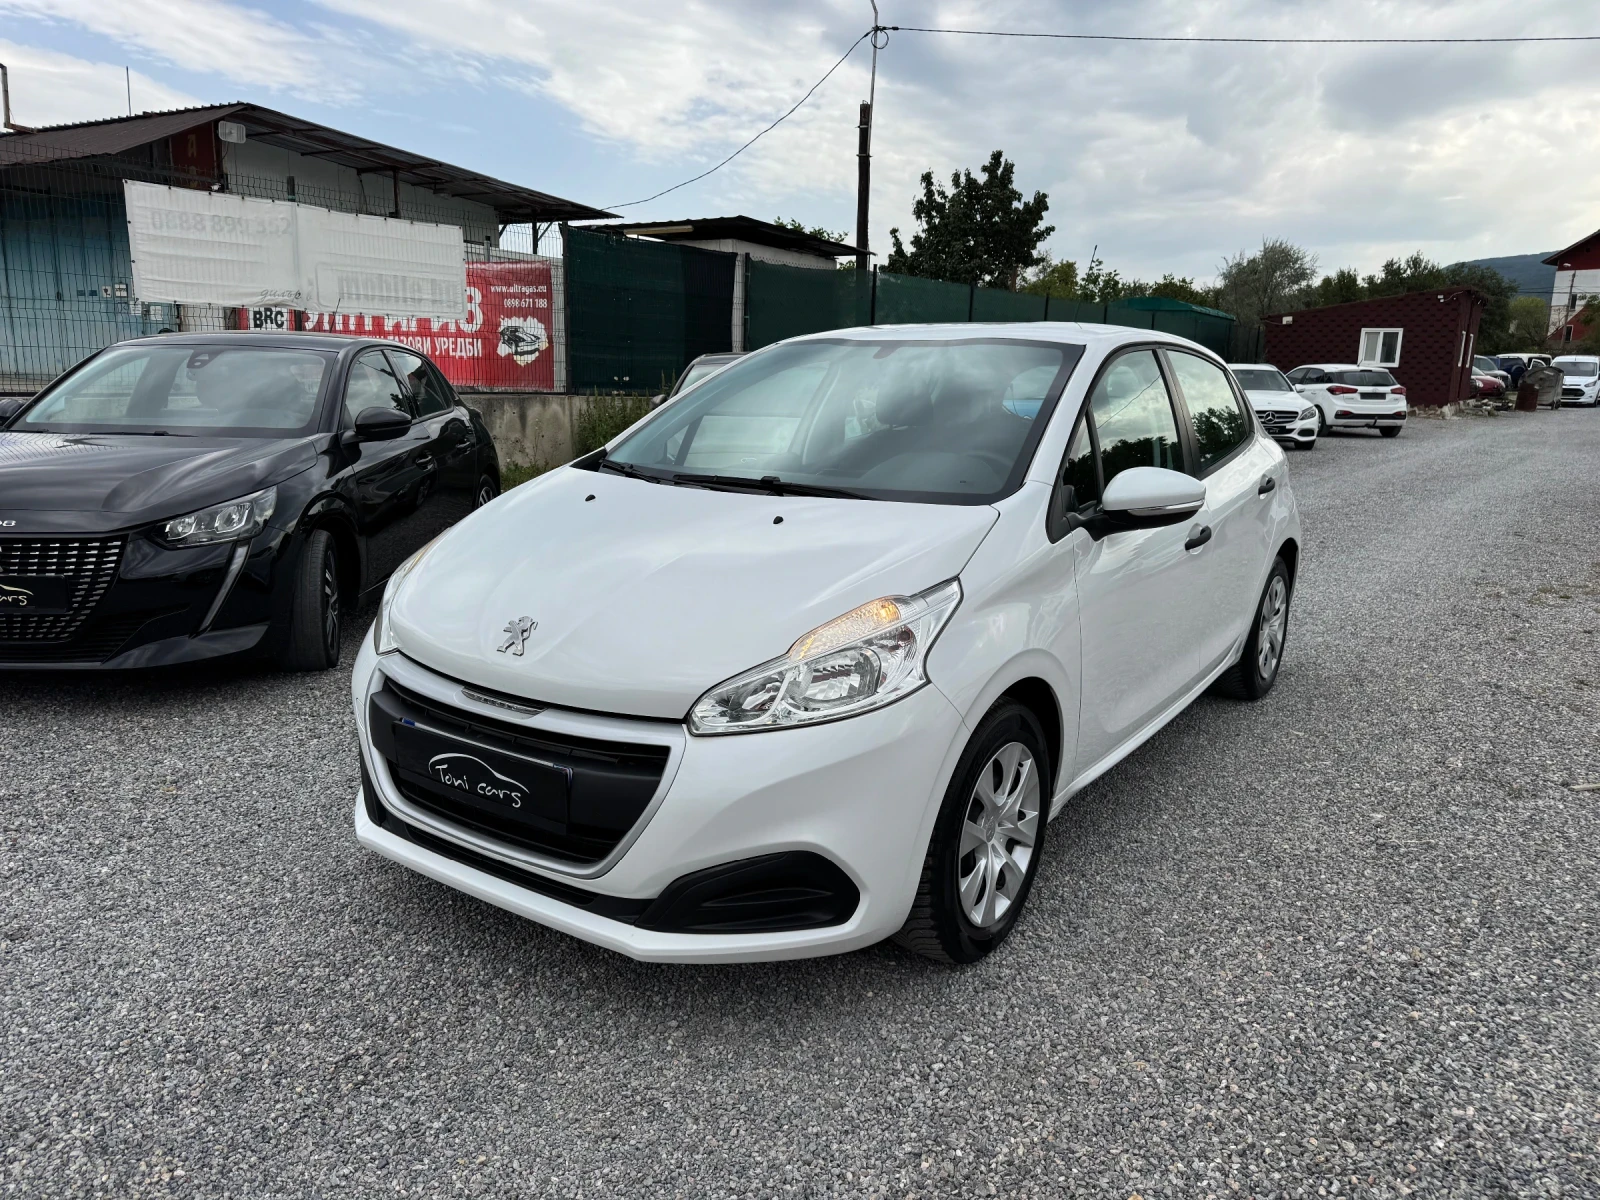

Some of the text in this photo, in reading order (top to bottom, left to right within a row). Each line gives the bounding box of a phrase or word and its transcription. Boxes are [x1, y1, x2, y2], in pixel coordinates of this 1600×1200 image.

[490, 284, 547, 295] www.ultragas.eu
[503, 298, 520, 308] 0898
[520, 298, 533, 308] 671
[253, 307, 284, 328] BRC
[434, 337, 482, 360] УРЕДБИ
[435, 764, 522, 808] Toni cars
